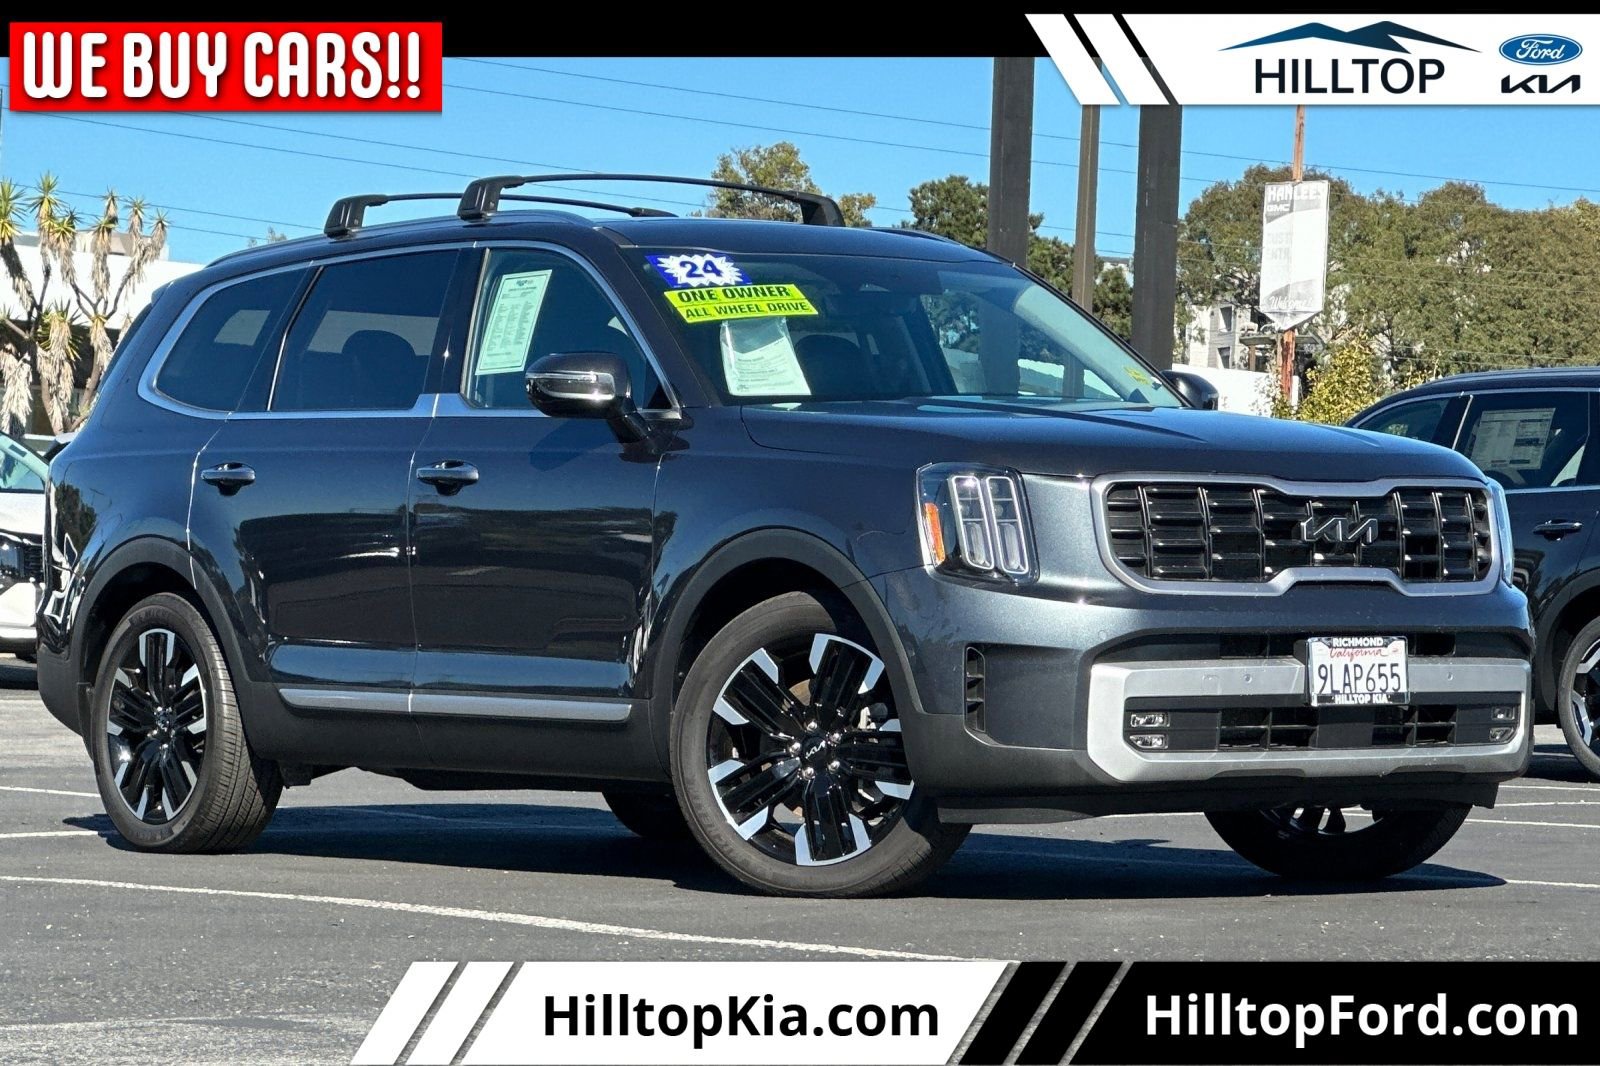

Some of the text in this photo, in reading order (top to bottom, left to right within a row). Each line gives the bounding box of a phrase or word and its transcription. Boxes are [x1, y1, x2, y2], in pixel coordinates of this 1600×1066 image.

[1266, 203, 1290, 212] GMC
[679, 259, 723, 279] 24
[677, 286, 790, 303] ONE OWNER
[685, 301, 810, 319] ALL WHEEL DRIVE
[1300, 516, 1379, 543] KIA
[1332, 637, 1384, 648] RICHMOND
[1329, 647, 1388, 662] California
[1318, 663, 1401, 694] 9LAP655
[1335, 693, 1370, 704] HILLTOP
